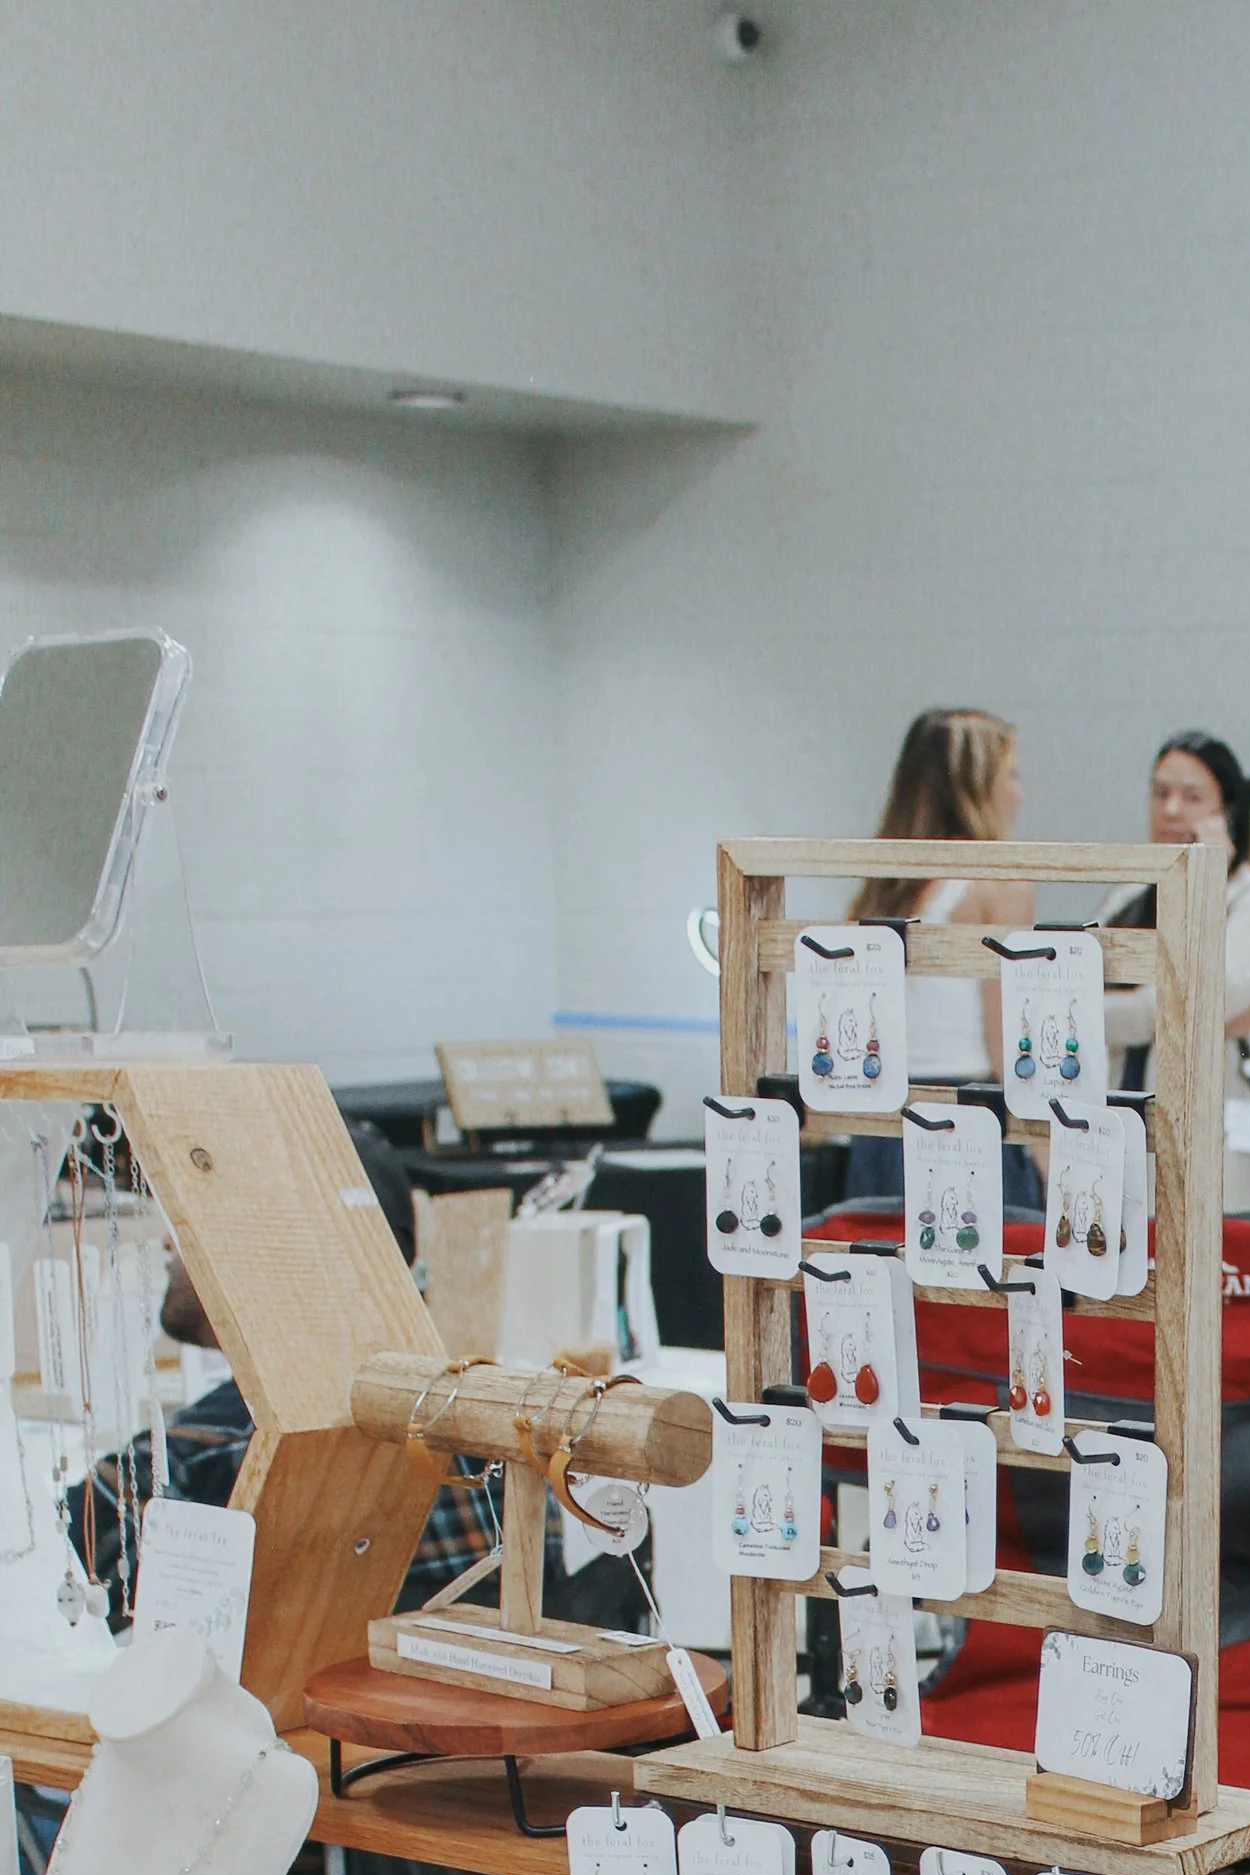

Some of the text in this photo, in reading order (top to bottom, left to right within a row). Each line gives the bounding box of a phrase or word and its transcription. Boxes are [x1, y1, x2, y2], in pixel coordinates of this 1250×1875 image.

[810, 960, 884, 974] the feral fox
[1014, 965, 1083, 979] the feral fox
[717, 1128, 781, 1144] the feral fox
[917, 1136, 982, 1154] the feral fox
[816, 1282, 874, 1296] the feral fox
[785, 1418, 802, 1427] $20
[727, 1432, 801, 1450] the feral fox
[881, 1448, 946, 1467] the feral fox
[1135, 1452, 1148, 1462] $20
[1083, 1466, 1147, 1489] the feral fox
[920, 1560, 938, 1573] Drop
[449, 1652, 469, 1667] Hand
[1082, 1655, 1140, 1686] Earrings
[1071, 1730, 1101, 1757] 50%
[582, 1835, 655, 1848] the feral fox
[692, 1851, 763, 1868] the feral fox
